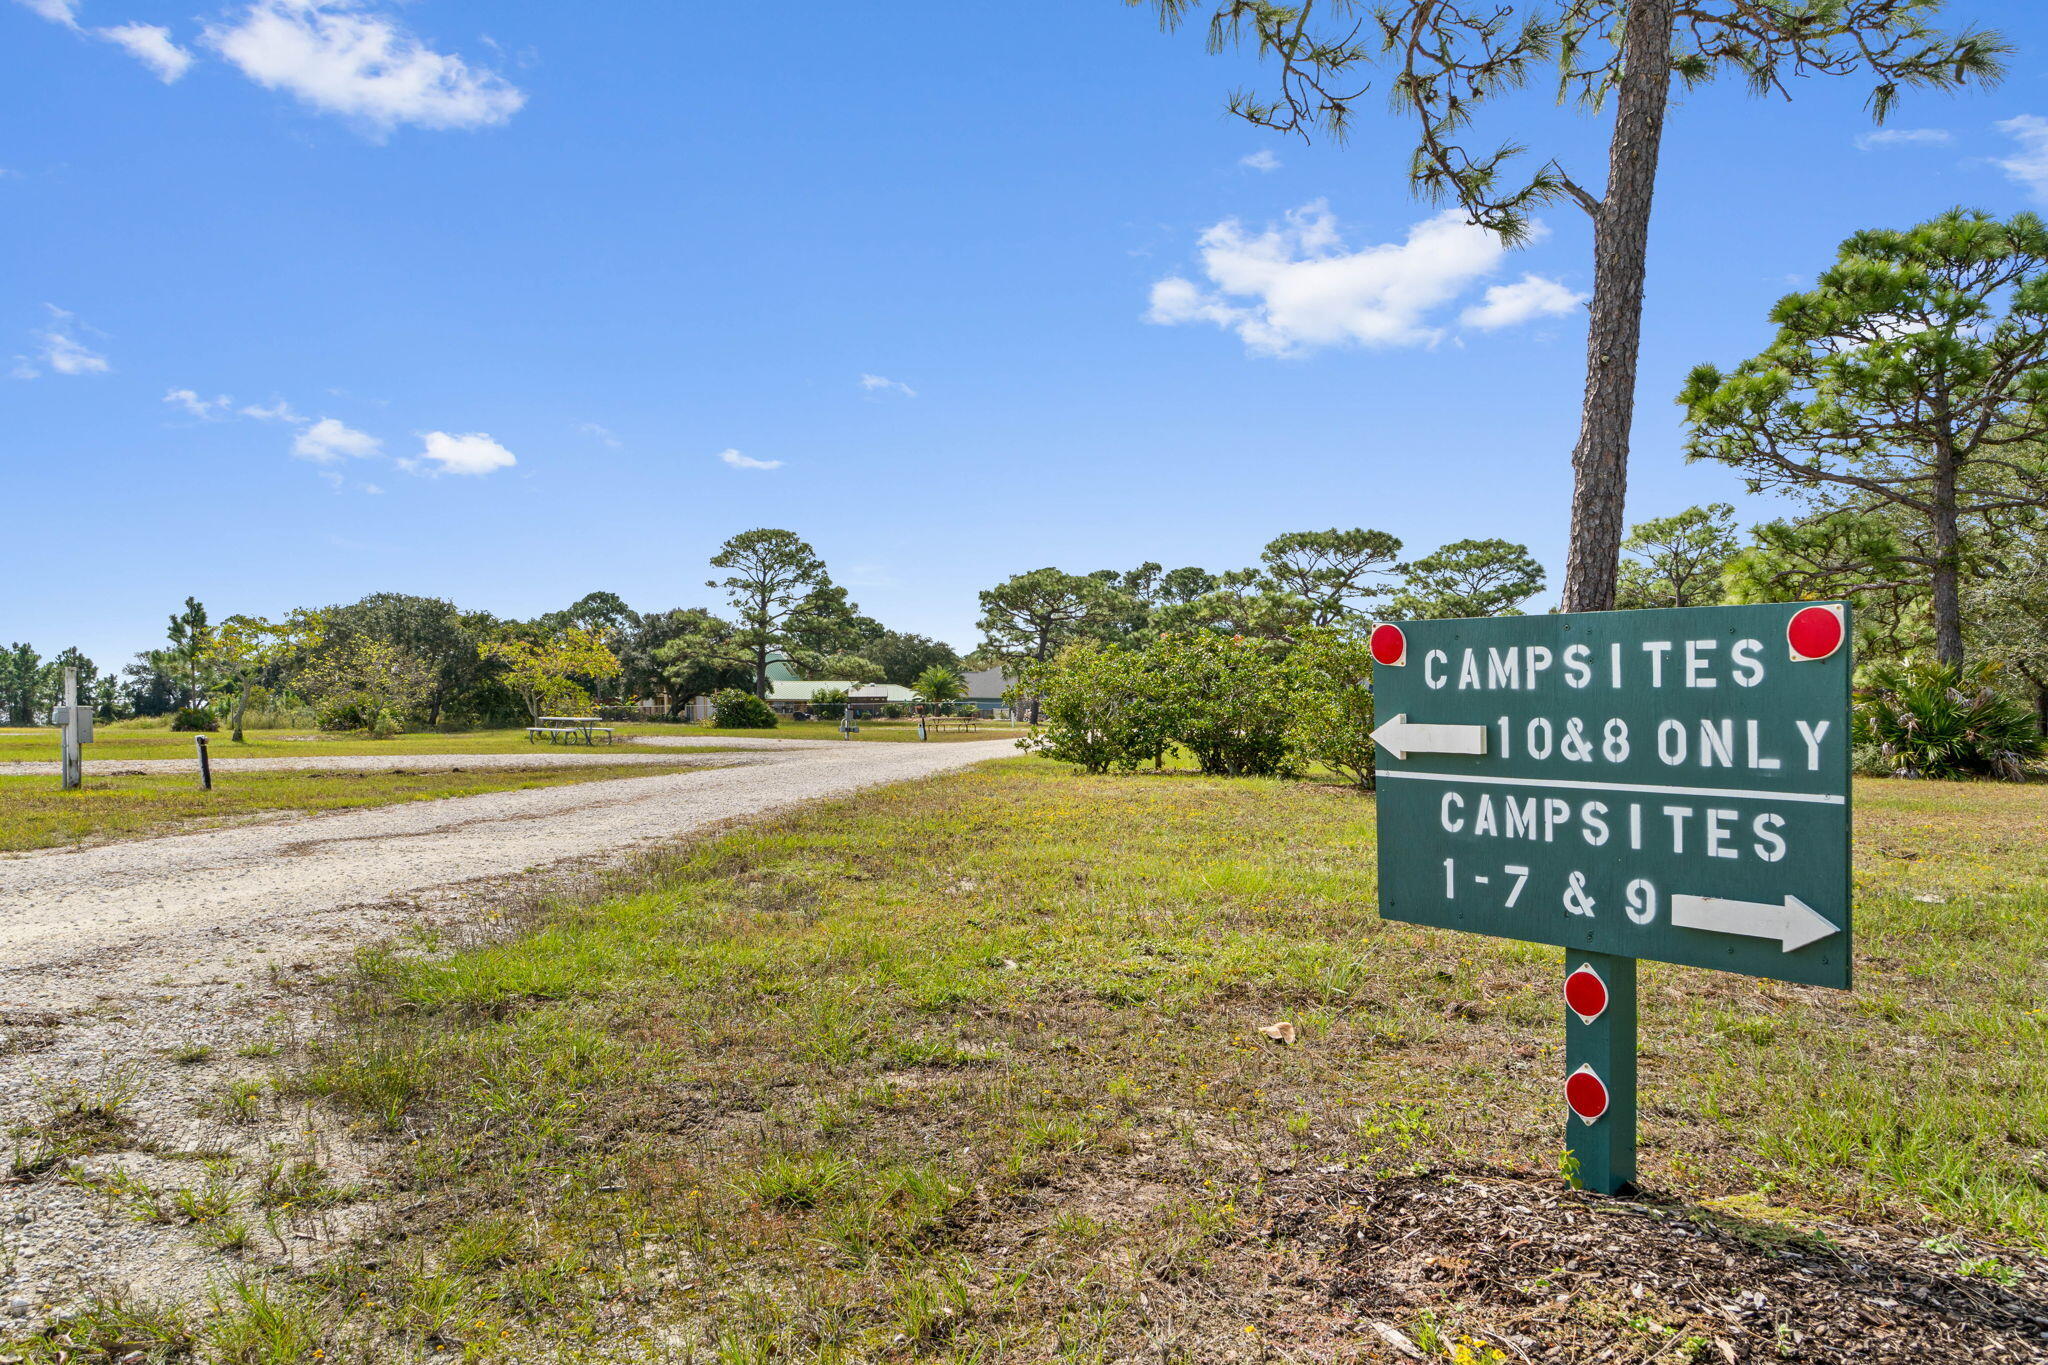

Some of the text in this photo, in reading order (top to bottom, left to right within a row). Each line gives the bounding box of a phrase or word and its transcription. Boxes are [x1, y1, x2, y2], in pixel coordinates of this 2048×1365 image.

[1424, 638, 1765, 690] CAMPSITES
[1497, 715, 1831, 771] 10&8 ONLY
[1440, 791, 1787, 863] CAMPSITES
[1562, 870, 1596, 918] &
[1624, 878, 1657, 925] 9
